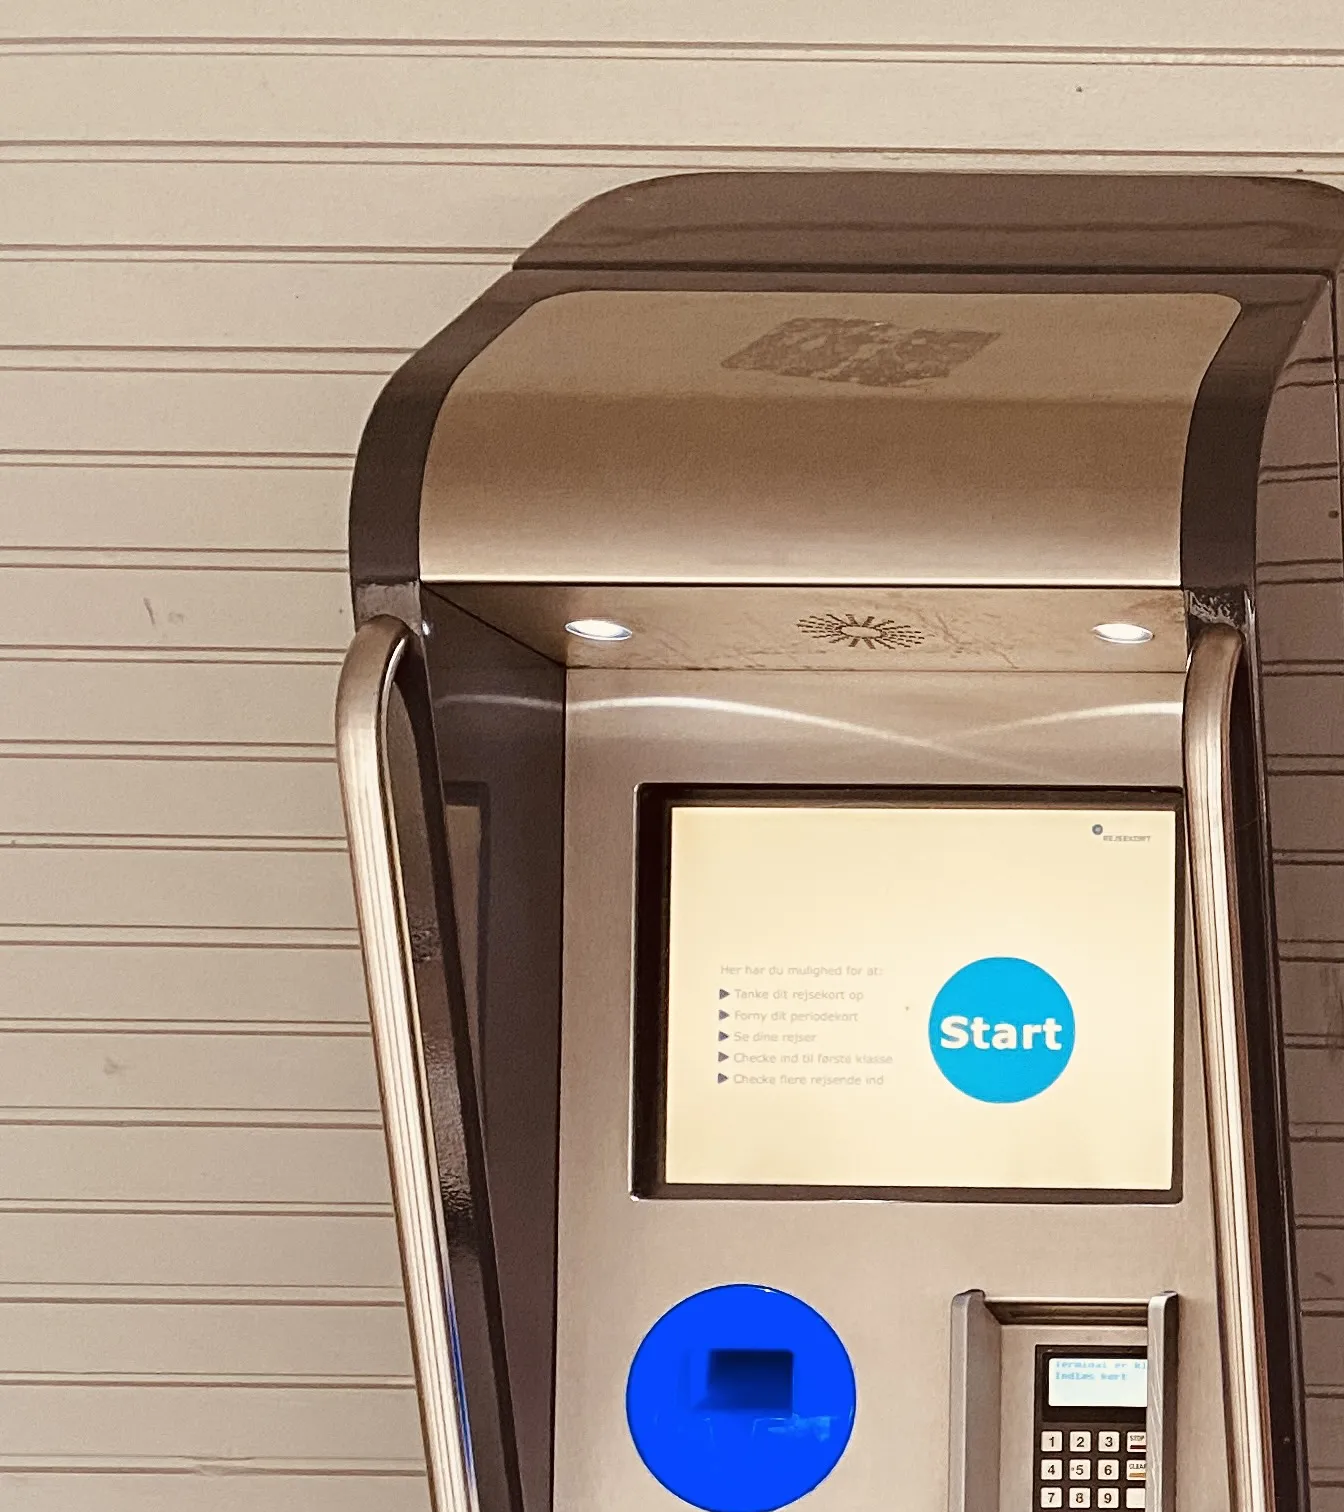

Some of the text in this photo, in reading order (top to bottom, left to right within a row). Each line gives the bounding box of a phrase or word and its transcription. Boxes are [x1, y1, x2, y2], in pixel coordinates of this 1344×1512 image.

[769, 965, 784, 976] du
[788, 966, 842, 978] mulighed
[734, 988, 864, 1003] Tanke dit rejsekort op
[771, 1010, 787, 1022] dit
[791, 1010, 859, 1024] periodekort
[734, 1032, 749, 1042] Se
[753, 1032, 778, 1042] dine
[940, 1015, 1062, 1051] Start
[1049, 1437, 1054, 1447] 1
[1076, 1437, 1084, 1447] 2
[1105, 1437, 1113, 1447] 3
[1048, 1465, 1055, 1475] 4
[1075, 1465, 1083, 1475] 5
[1104, 1465, 1112, 1475] 6
[1048, 1493, 1112, 1503] 7 8 9
